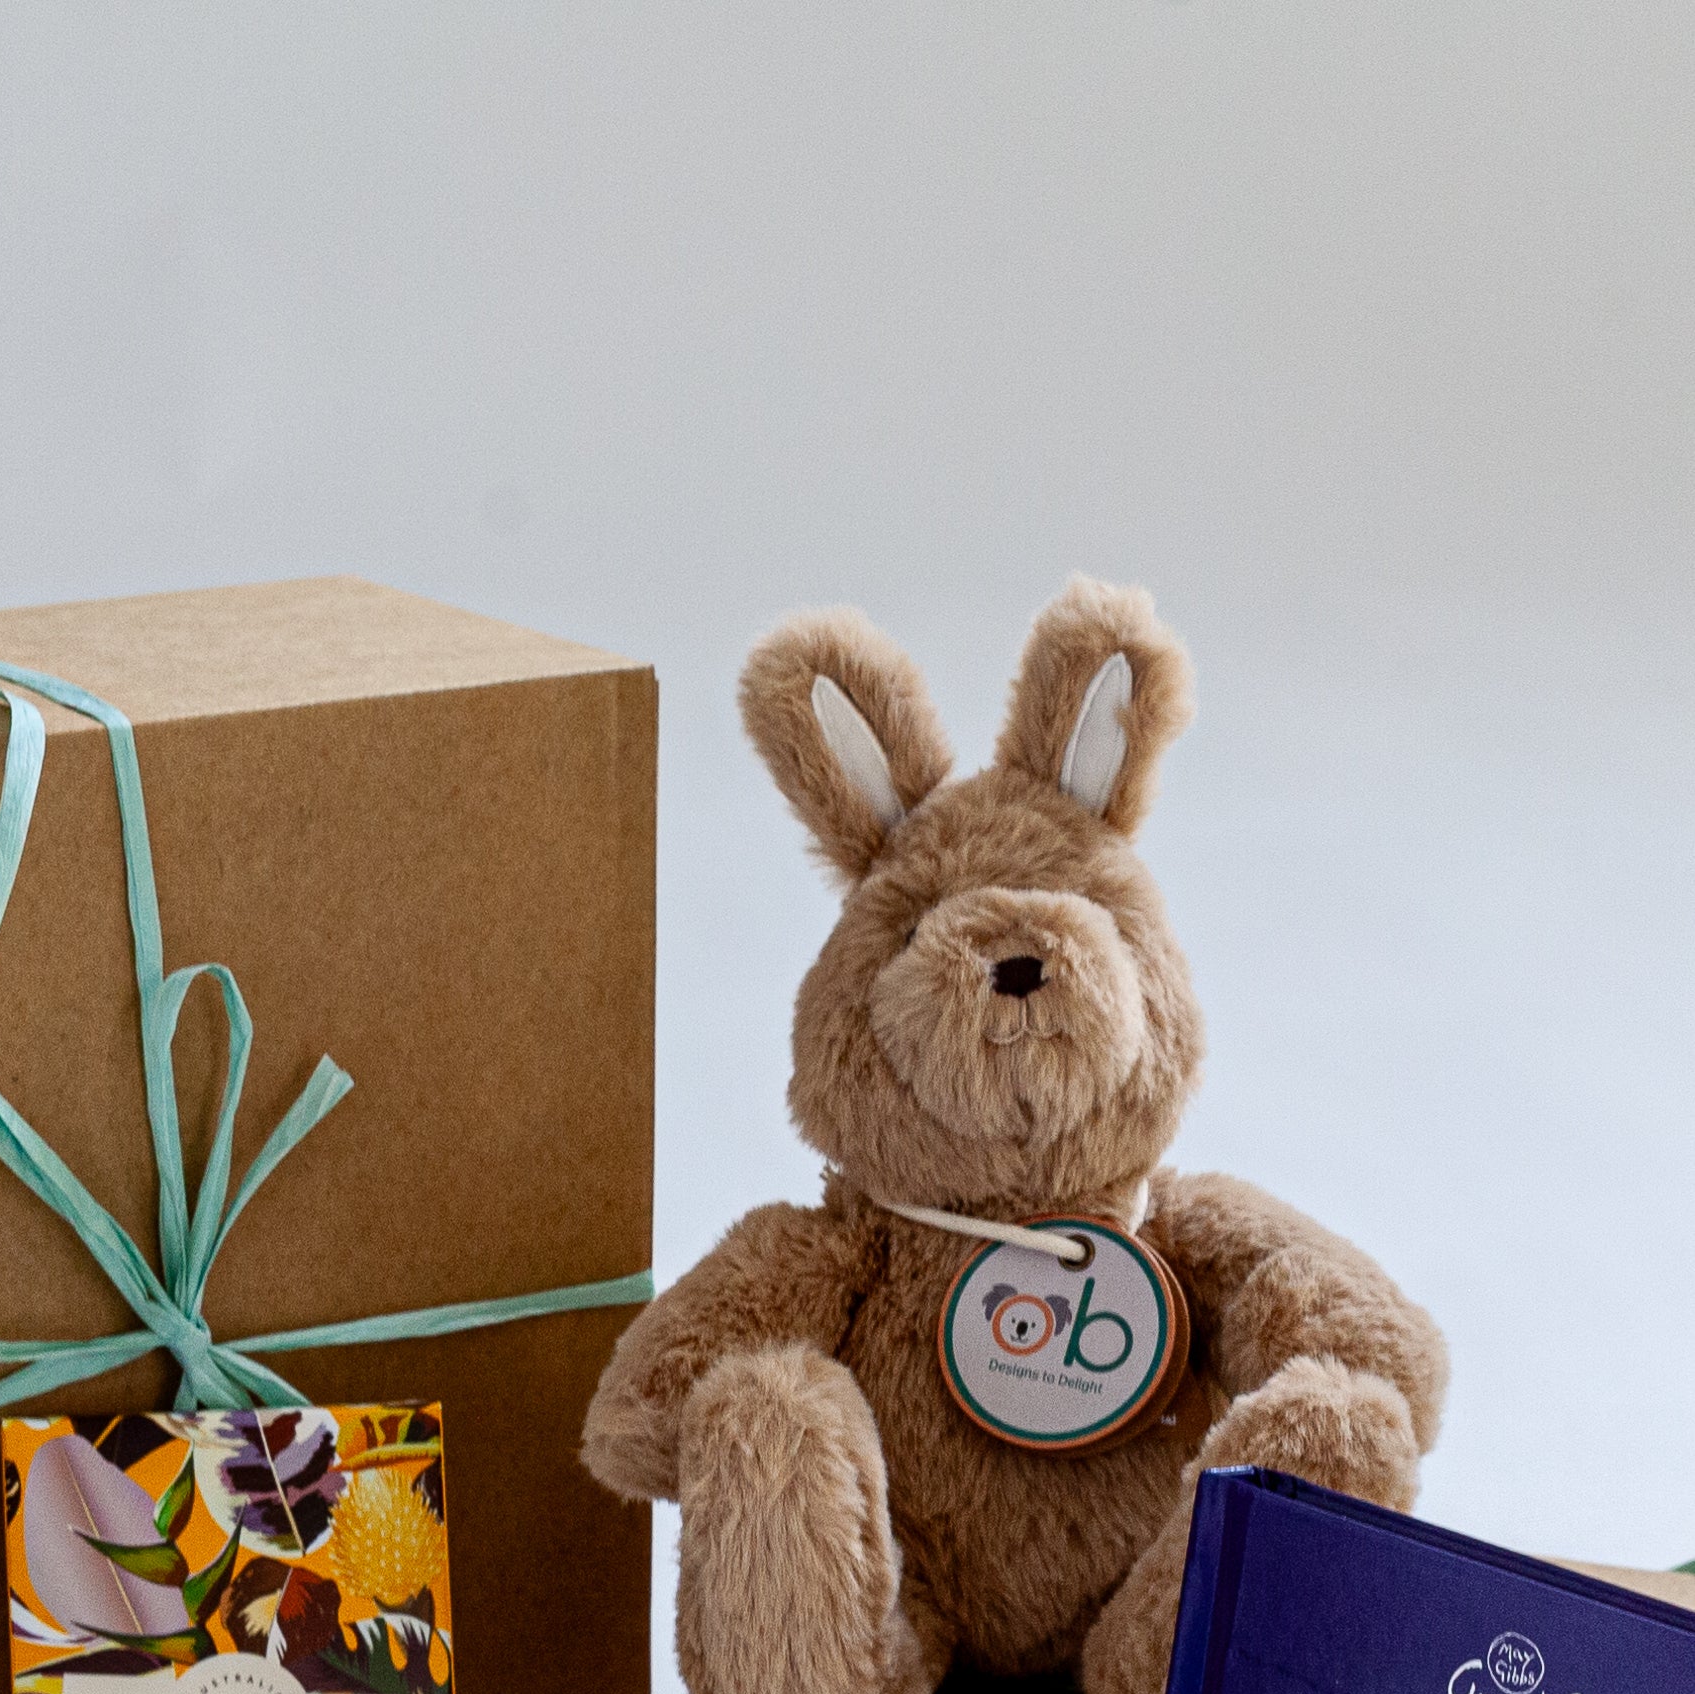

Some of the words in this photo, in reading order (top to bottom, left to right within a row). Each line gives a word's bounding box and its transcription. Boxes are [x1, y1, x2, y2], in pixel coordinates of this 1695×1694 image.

[988, 1358, 1041, 1380] Designs
[1042, 1369, 1056, 1385] to
[1058, 1372, 1104, 1395] Delight
[1498, 1642, 1535, 1669] May
[1494, 1659, 1536, 1687] Gibbs
